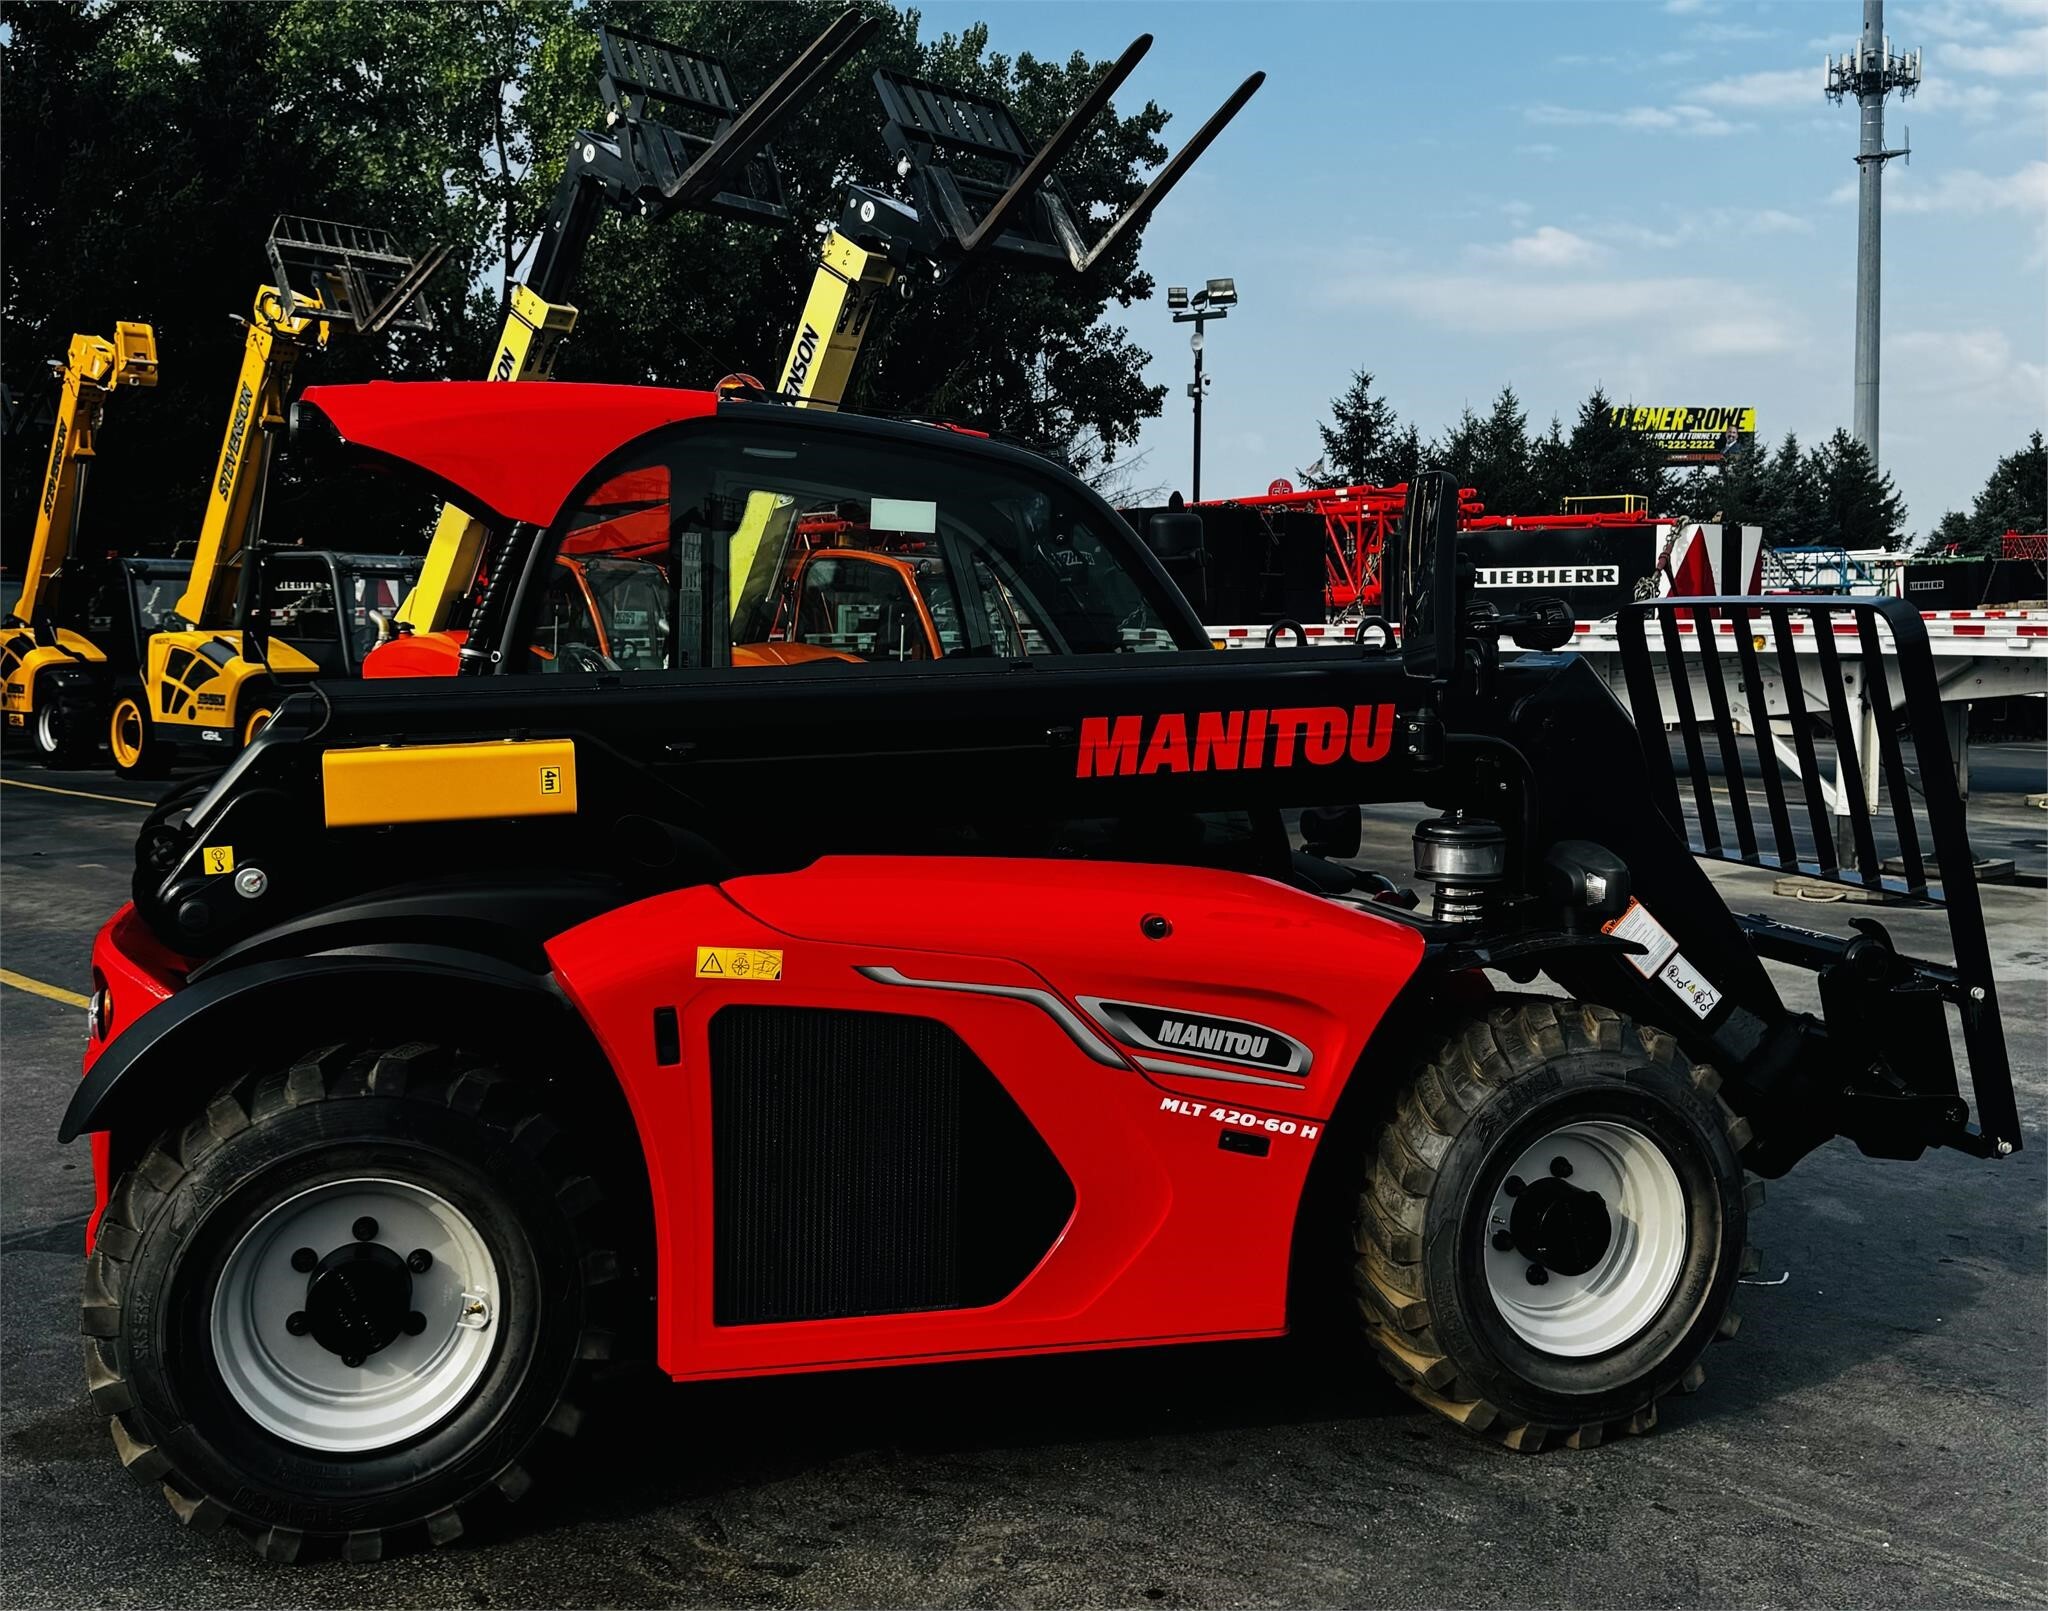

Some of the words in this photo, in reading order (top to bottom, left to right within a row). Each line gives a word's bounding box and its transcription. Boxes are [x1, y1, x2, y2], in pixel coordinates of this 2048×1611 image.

[493, 346, 516, 381] ON
[1677, 432, 1722, 440] ATTORNEYS
[1692, 407, 1749, 430] ROWE
[219, 381, 252, 502] STEVENSON
[1475, 568, 1616, 585] LIEBHERR
[1076, 703, 1396, 779] MANITOU
[545, 770, 558, 791] 4m
[1157, 1019, 1270, 1058] MANITOU
[1160, 1097, 1207, 1117] MLT
[1209, 1107, 1297, 1135] 420-60
[1300, 1124, 1318, 1140] H
